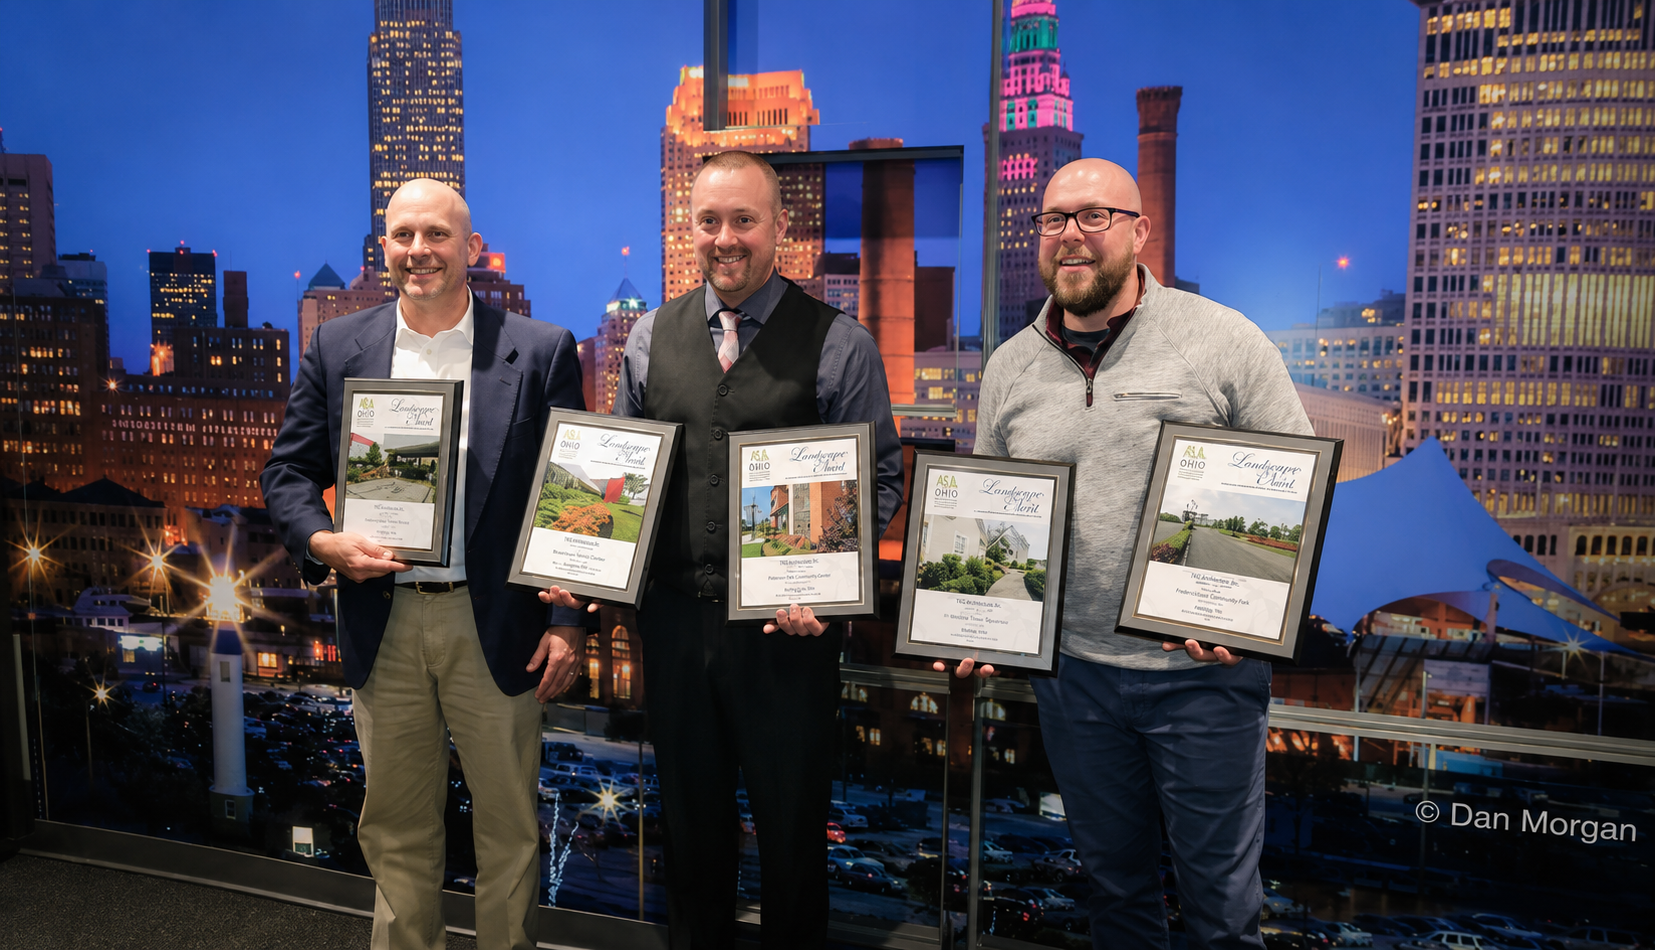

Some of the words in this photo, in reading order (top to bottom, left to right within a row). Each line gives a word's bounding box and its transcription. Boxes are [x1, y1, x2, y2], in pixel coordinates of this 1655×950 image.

[560, 440, 580, 450] OHIO
[1180, 459, 1206, 470] OHIO
[934, 488, 958, 499] OHIO
